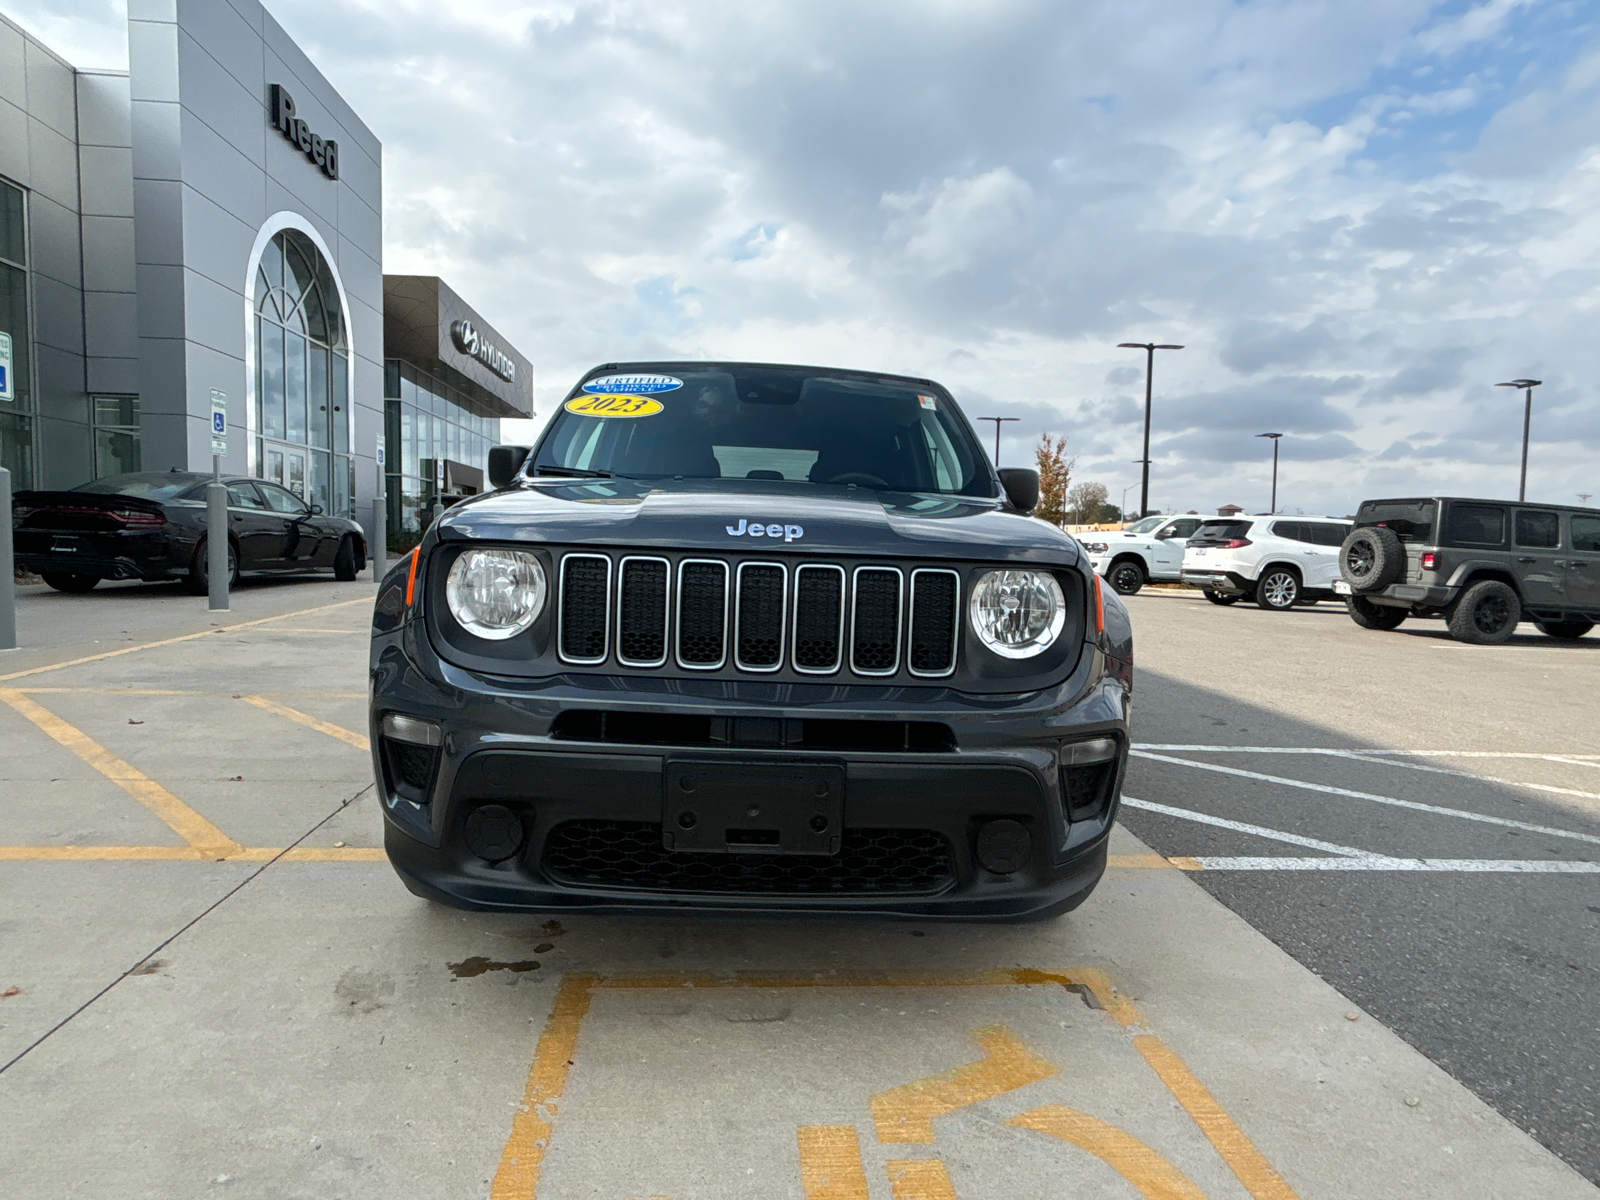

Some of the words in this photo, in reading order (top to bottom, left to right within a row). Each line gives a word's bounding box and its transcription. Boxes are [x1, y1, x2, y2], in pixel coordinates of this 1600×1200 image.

[271, 84, 339, 181] Reed
[480, 336, 515, 382] HYUNDAI
[595, 377, 673, 385] CERTIFIED
[575, 397, 648, 412] 2023
[725, 519, 804, 542] Jeep
